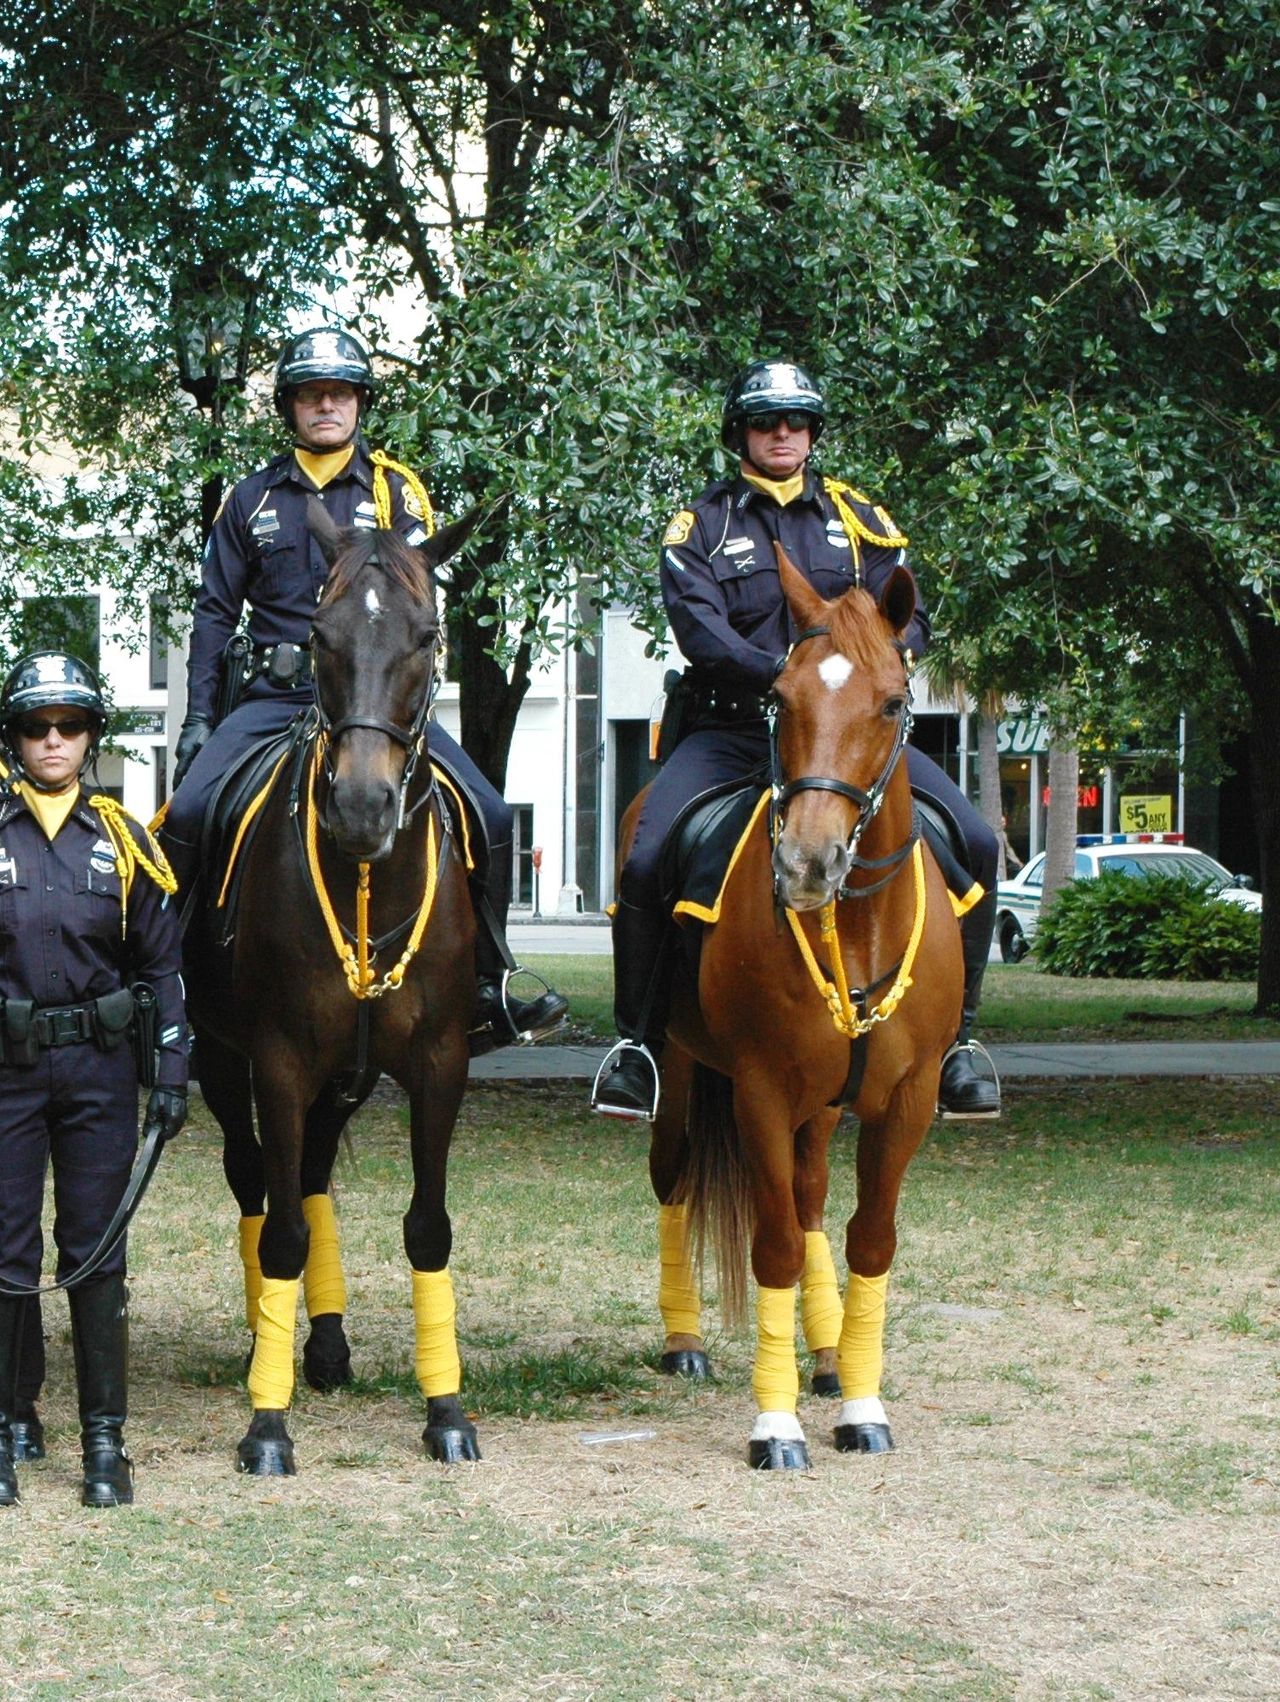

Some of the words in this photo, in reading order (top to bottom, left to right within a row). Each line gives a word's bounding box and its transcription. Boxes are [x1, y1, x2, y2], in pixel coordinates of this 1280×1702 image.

[1042, 785, 1099, 807] ON
[1126, 803, 1148, 829] $5
[1149, 813, 1166, 823] ANY
